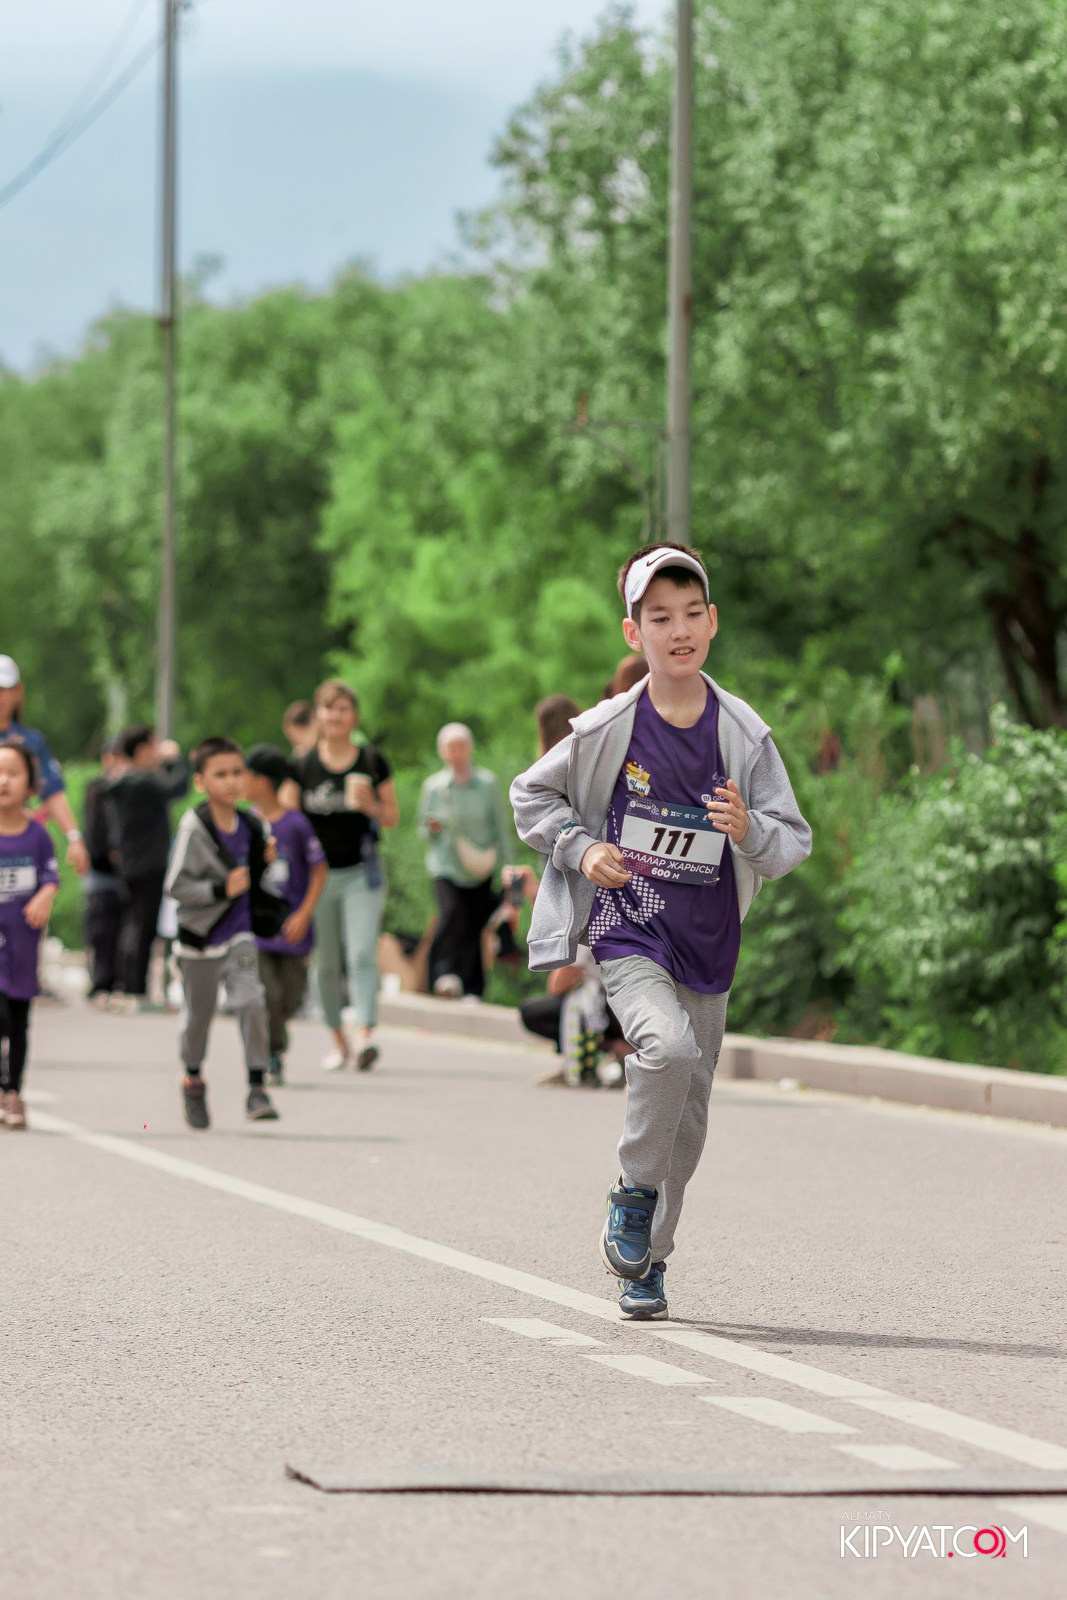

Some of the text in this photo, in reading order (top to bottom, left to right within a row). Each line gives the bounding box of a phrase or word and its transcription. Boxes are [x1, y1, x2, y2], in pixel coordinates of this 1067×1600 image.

[651, 827, 696, 857] 111
[621, 849, 714, 874] БАЛАЛАР ЖАРЫСЫ
[651, 867, 671, 878] 600
